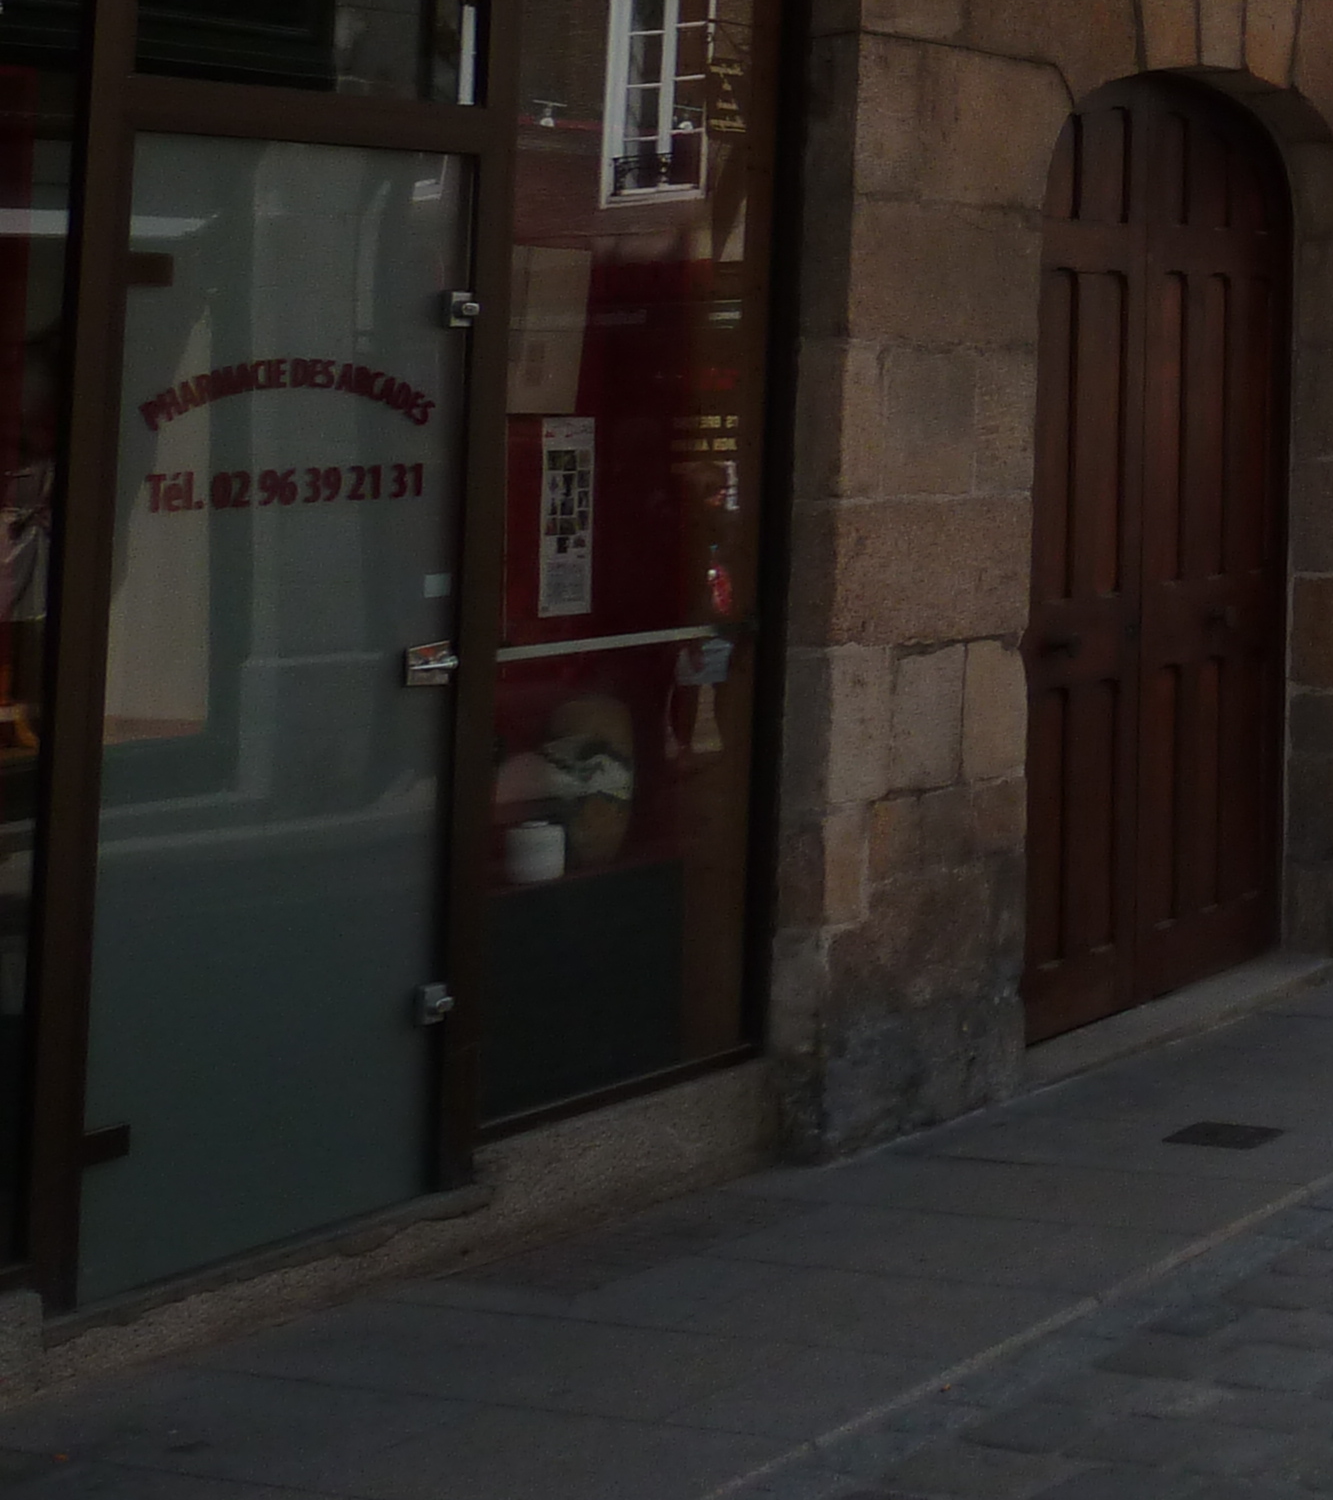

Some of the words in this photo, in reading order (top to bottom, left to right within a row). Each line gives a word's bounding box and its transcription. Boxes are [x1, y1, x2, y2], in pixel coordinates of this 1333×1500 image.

[139, 358, 288, 432] PHARMACIE
[289, 357, 337, 389] DES
[336, 362, 436, 426] ARCADES
[145, 470, 206, 514] Tél.
[211, 470, 251, 510] 02
[257, 468, 299, 507] 96
[303, 466, 342, 504] 39
[346, 465, 382, 501] 21
[390, 462, 424, 499] 31
